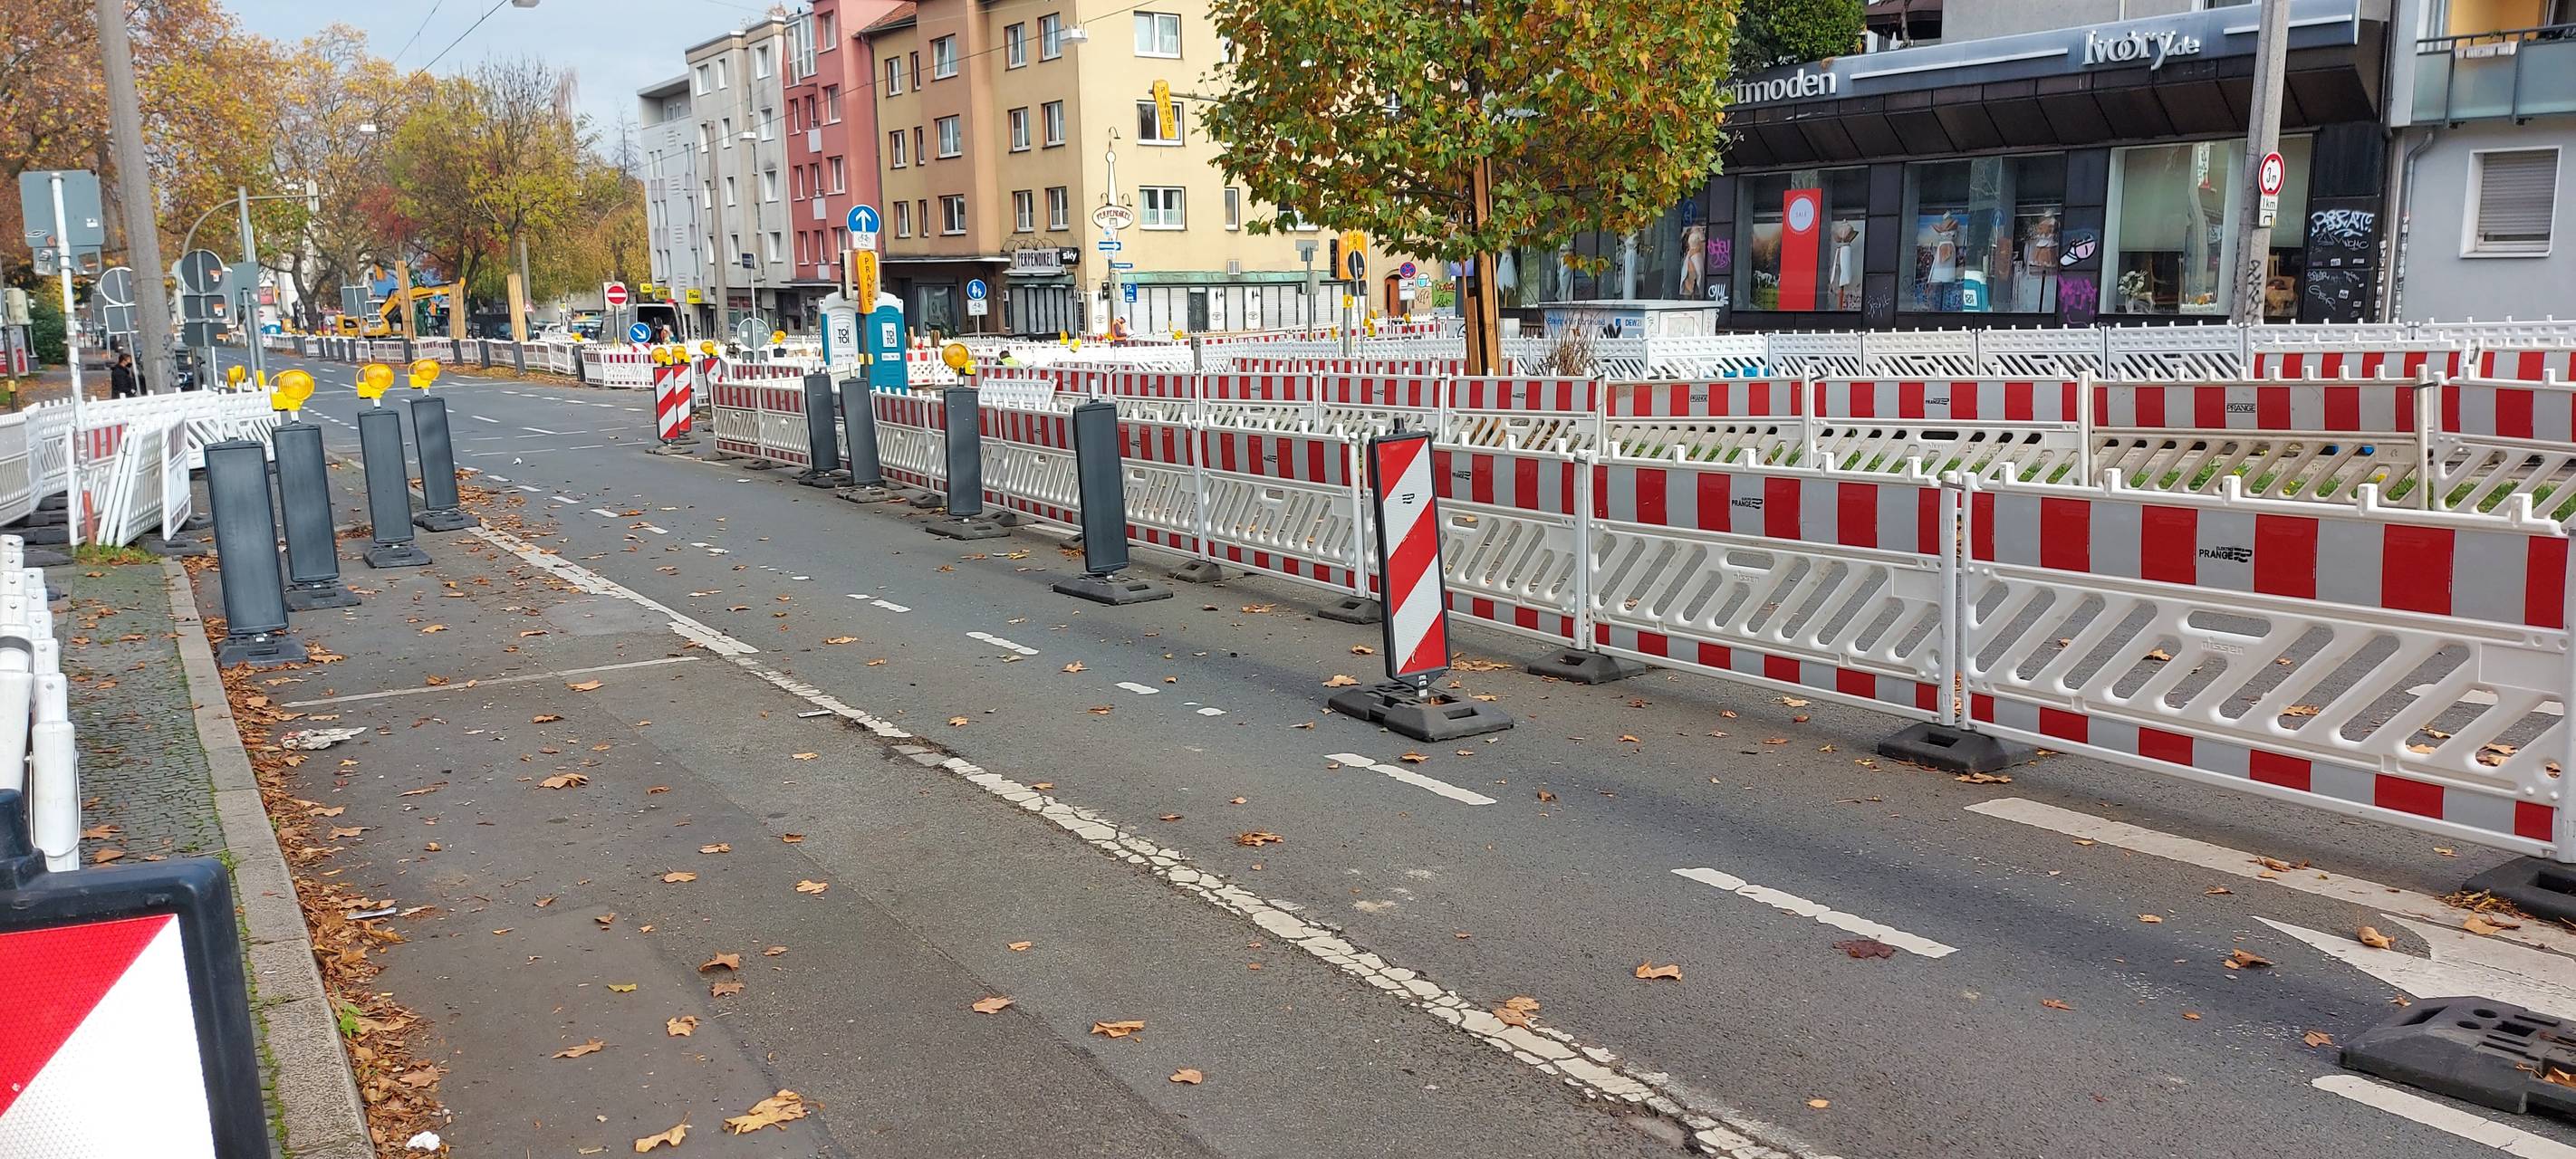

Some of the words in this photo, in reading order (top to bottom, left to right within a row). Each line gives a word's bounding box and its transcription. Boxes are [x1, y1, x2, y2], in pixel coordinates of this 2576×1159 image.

[1160, 87, 1173, 130] PRANGE
[1096, 208, 1132, 222] PERPENDIKEL
[1017, 251, 1054, 267] PERPENDIKEL
[1062, 250, 1077, 262] sky
[863, 257, 874, 306] PRANGE
[1625, 319, 1642, 327] DEW21
[838, 328, 850, 336] TOI
[839, 336, 850, 344] TOI
[887, 337, 895, 345] TOI
[2198, 549, 2234, 560] PRANGE
[2201, 636, 2244, 656] nissen
